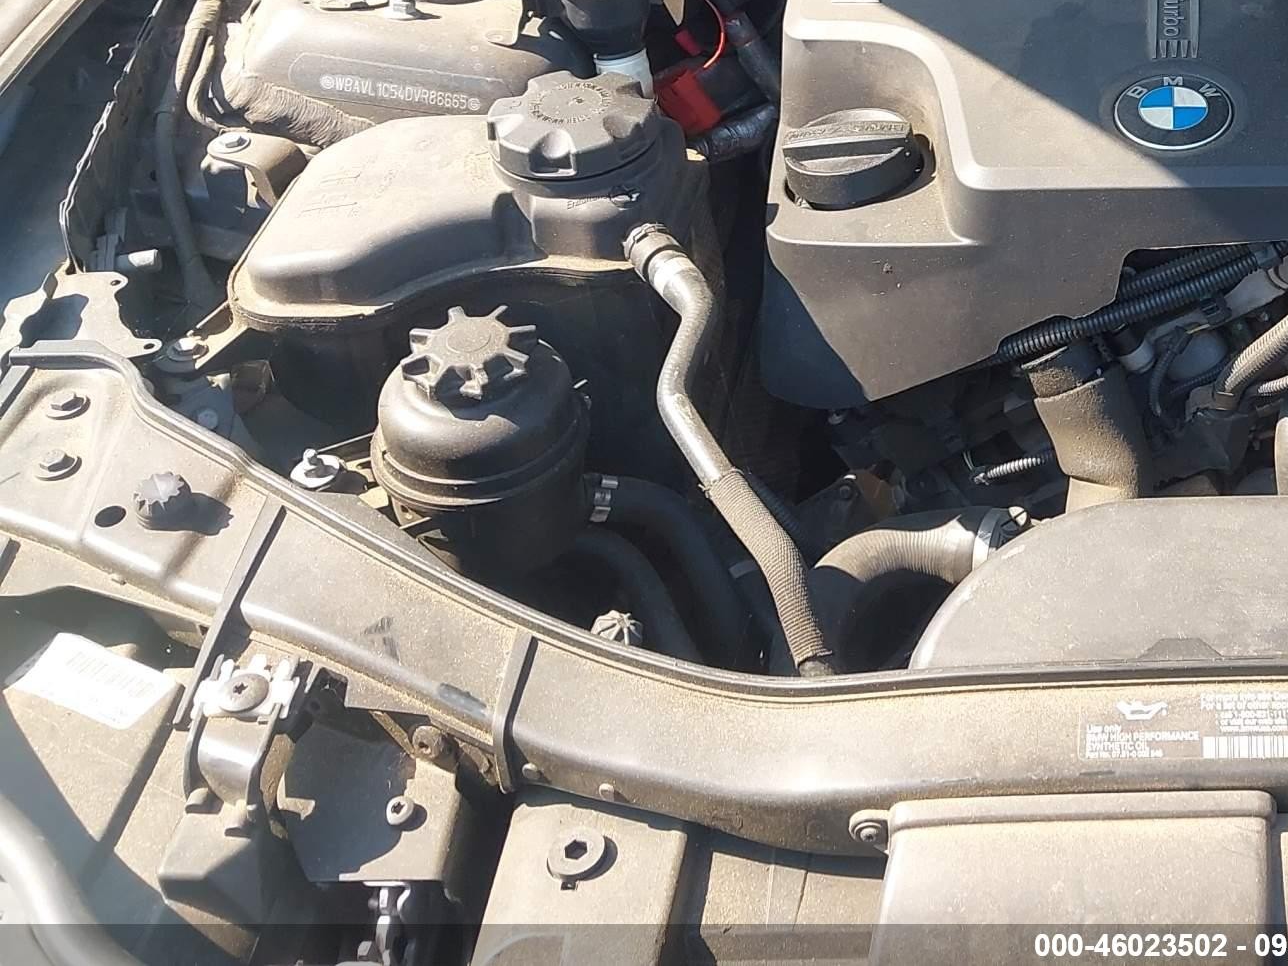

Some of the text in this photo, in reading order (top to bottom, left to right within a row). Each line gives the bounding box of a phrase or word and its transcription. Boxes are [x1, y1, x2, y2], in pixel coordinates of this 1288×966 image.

[335, 76, 468, 110] WBAVL1C54DVR86665
[1126, 75, 1222, 100] BMW
[1110, 732, 1132, 741] HIGH
[1133, 731, 1199, 741] PERFORMANCE
[1086, 740, 1148, 751] SYNTHETIC OIL
